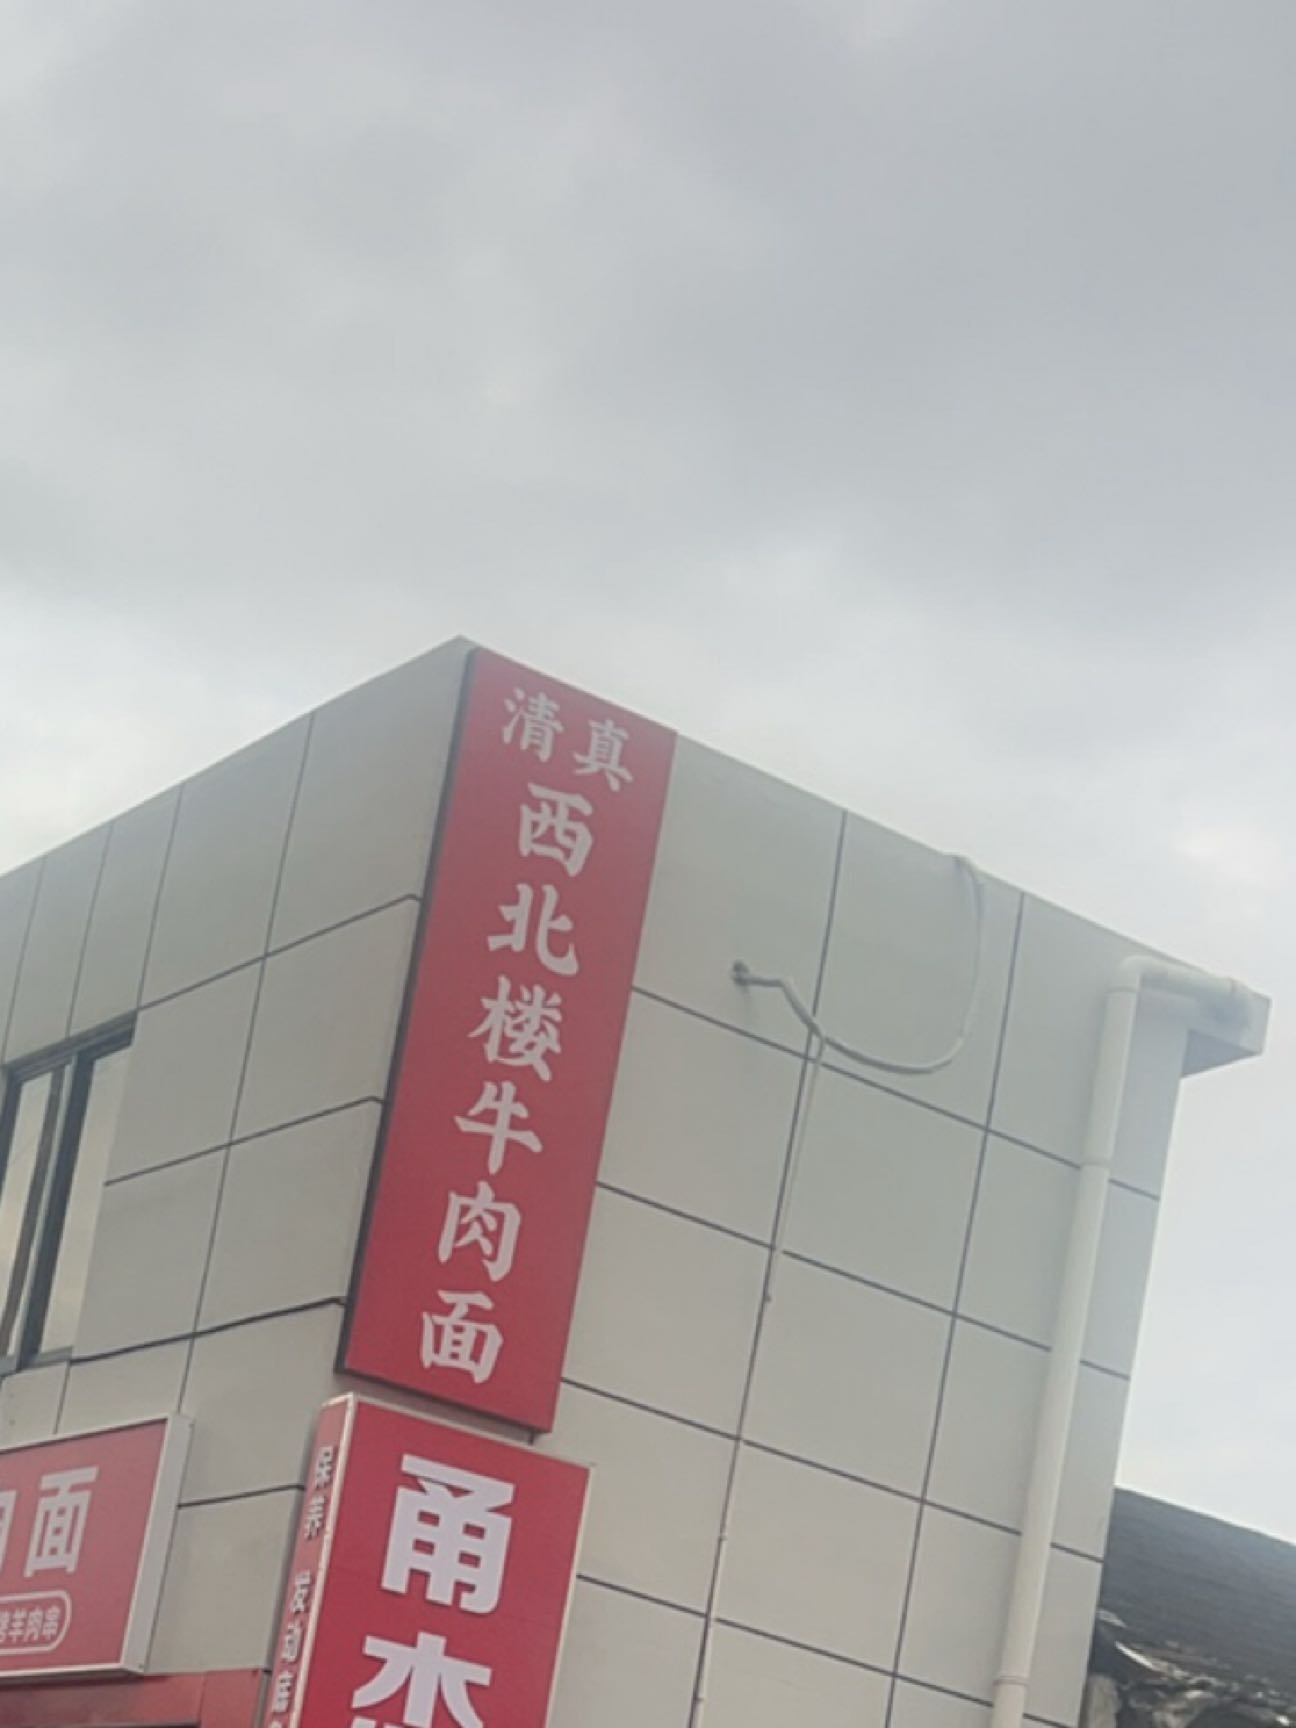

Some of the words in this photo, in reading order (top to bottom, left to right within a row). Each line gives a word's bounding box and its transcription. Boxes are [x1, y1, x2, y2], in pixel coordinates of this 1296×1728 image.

[503, 686, 633, 792] 清真
[418, 782, 595, 1384] 西北楼牛肉面
